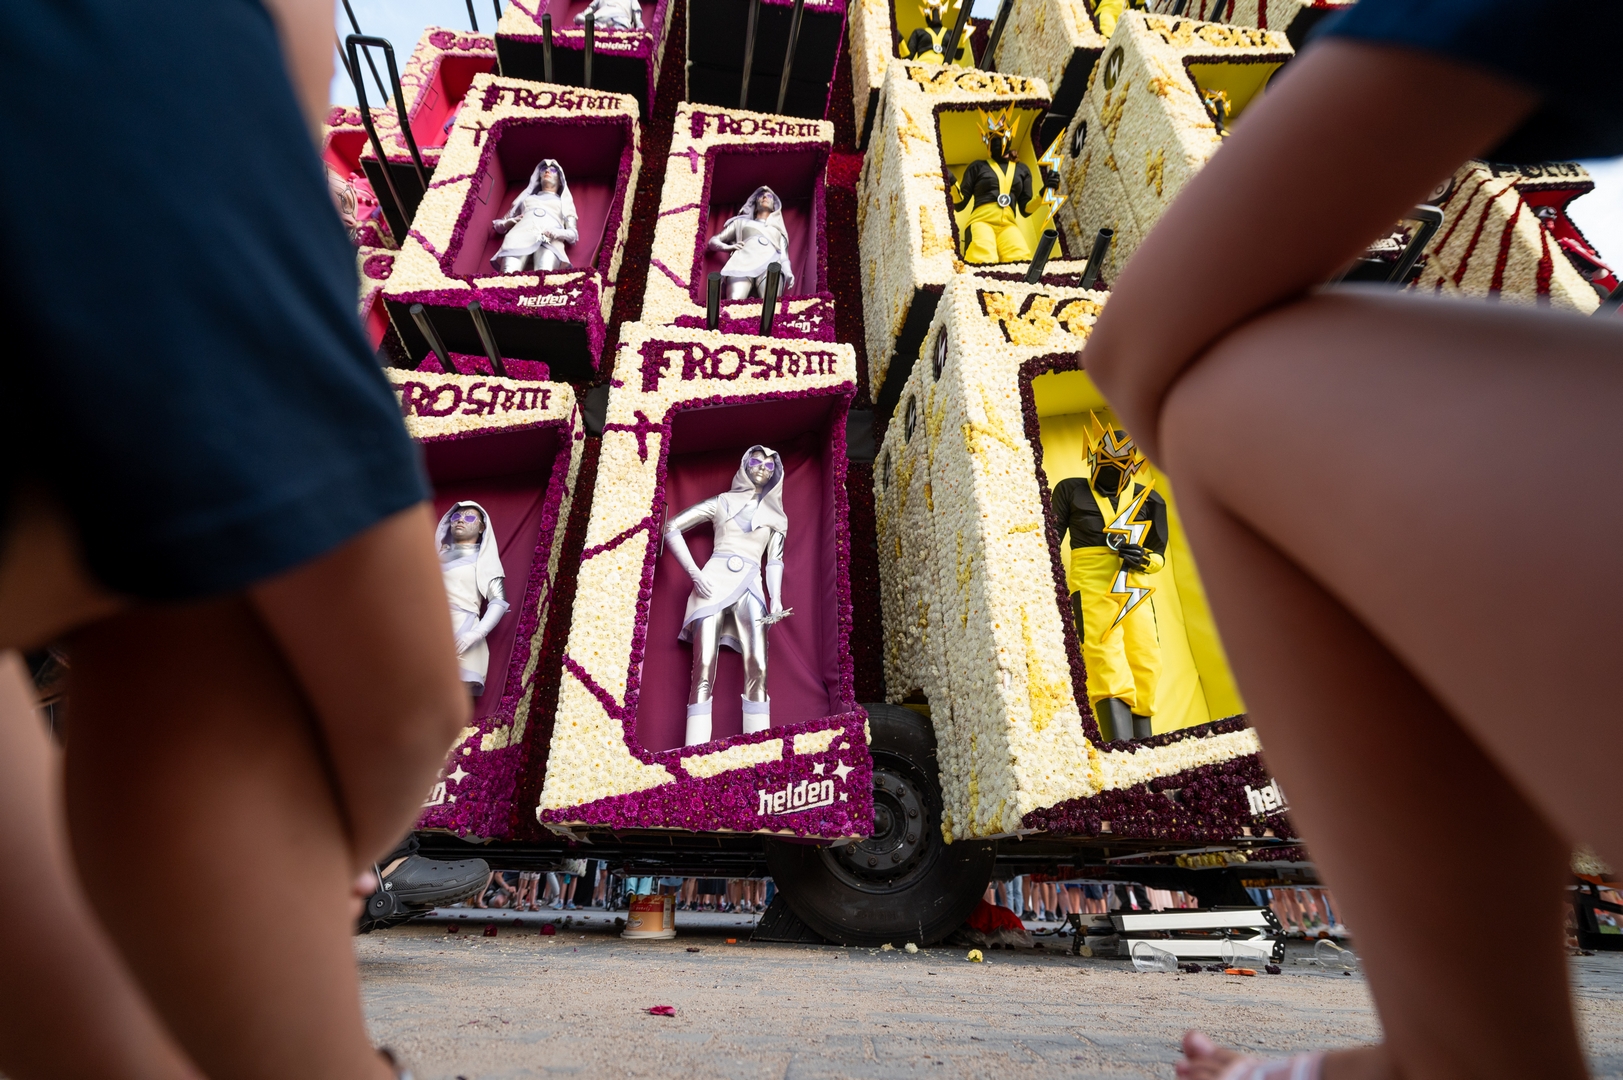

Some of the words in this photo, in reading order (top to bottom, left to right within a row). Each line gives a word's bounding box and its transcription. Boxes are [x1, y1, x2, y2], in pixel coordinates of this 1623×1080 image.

[480, 82, 623, 112] FROSTBITE
[688, 110, 821, 139] FROSTBITE
[517, 293, 569, 307] helden
[637, 338, 838, 393] FROSTBITE
[390, 381, 552, 417] ROSTBITE
[757, 779, 835, 816] helden
[1244, 777, 1291, 817] hel
